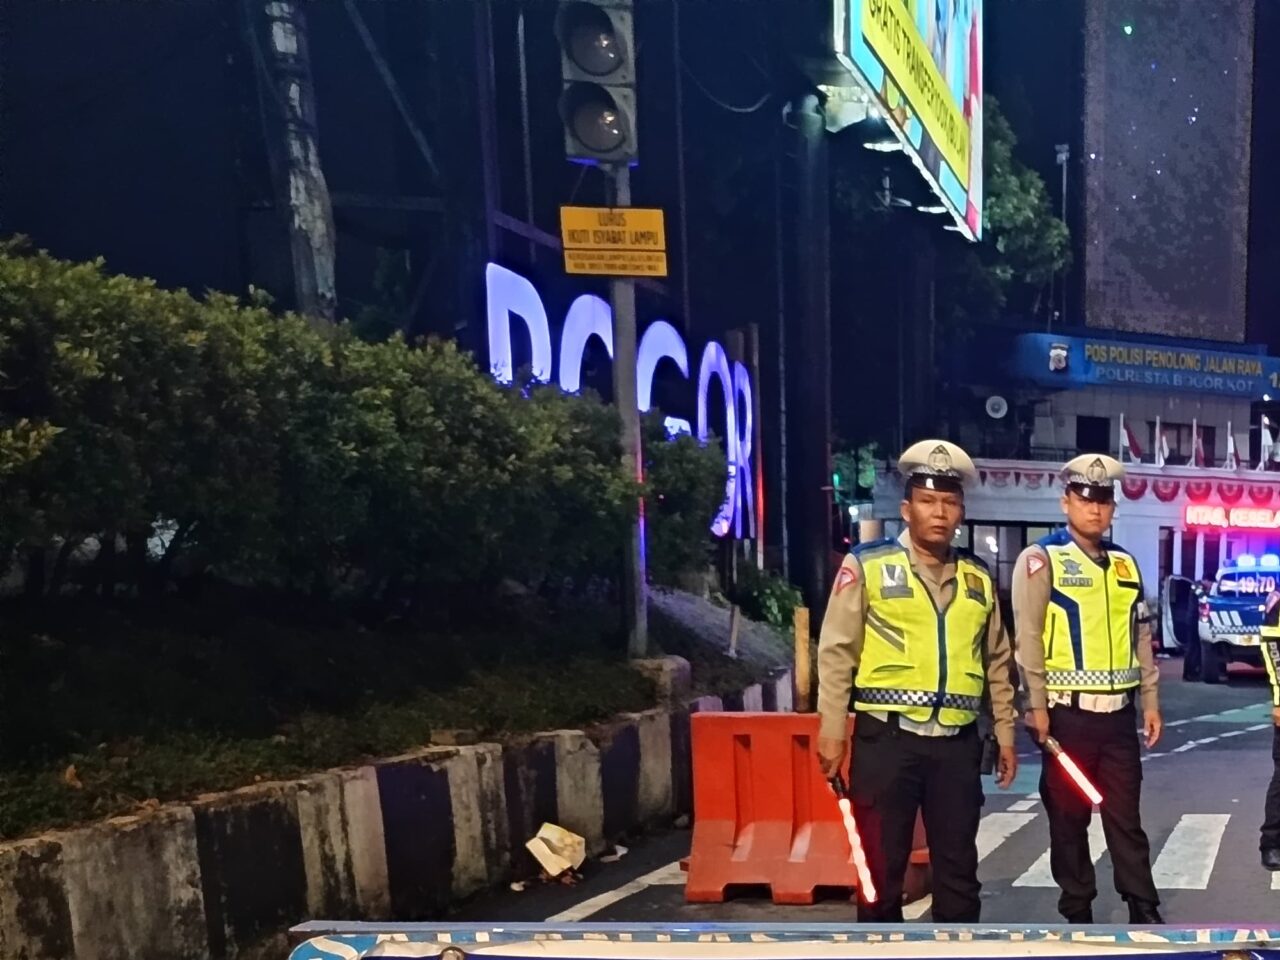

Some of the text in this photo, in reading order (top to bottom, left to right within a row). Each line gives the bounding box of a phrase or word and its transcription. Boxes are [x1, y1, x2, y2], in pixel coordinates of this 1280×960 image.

[1085, 344, 1264, 377] POS POLISI PENOLONG JALAN RAYA
